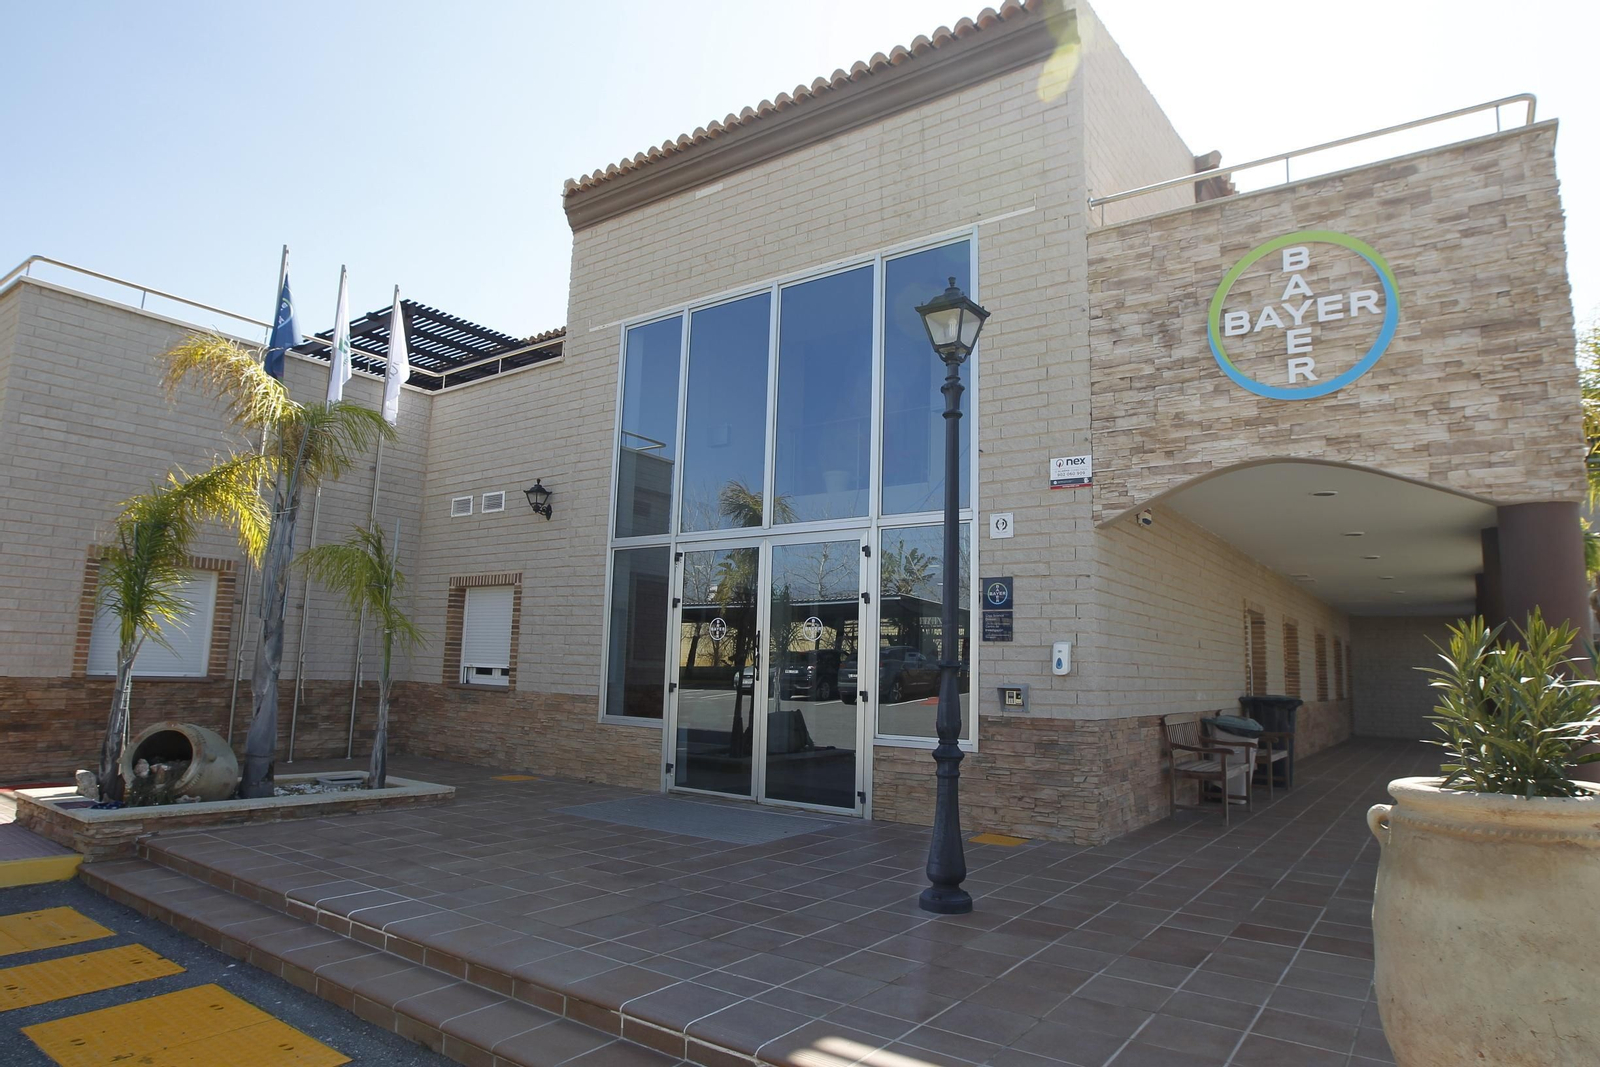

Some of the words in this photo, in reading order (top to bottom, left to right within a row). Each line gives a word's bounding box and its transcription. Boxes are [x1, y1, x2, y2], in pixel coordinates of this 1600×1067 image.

[1224, 289, 1382, 337] BAYER
[1281, 246, 1319, 384] BAYER
[1066, 457, 1086, 466] nex
